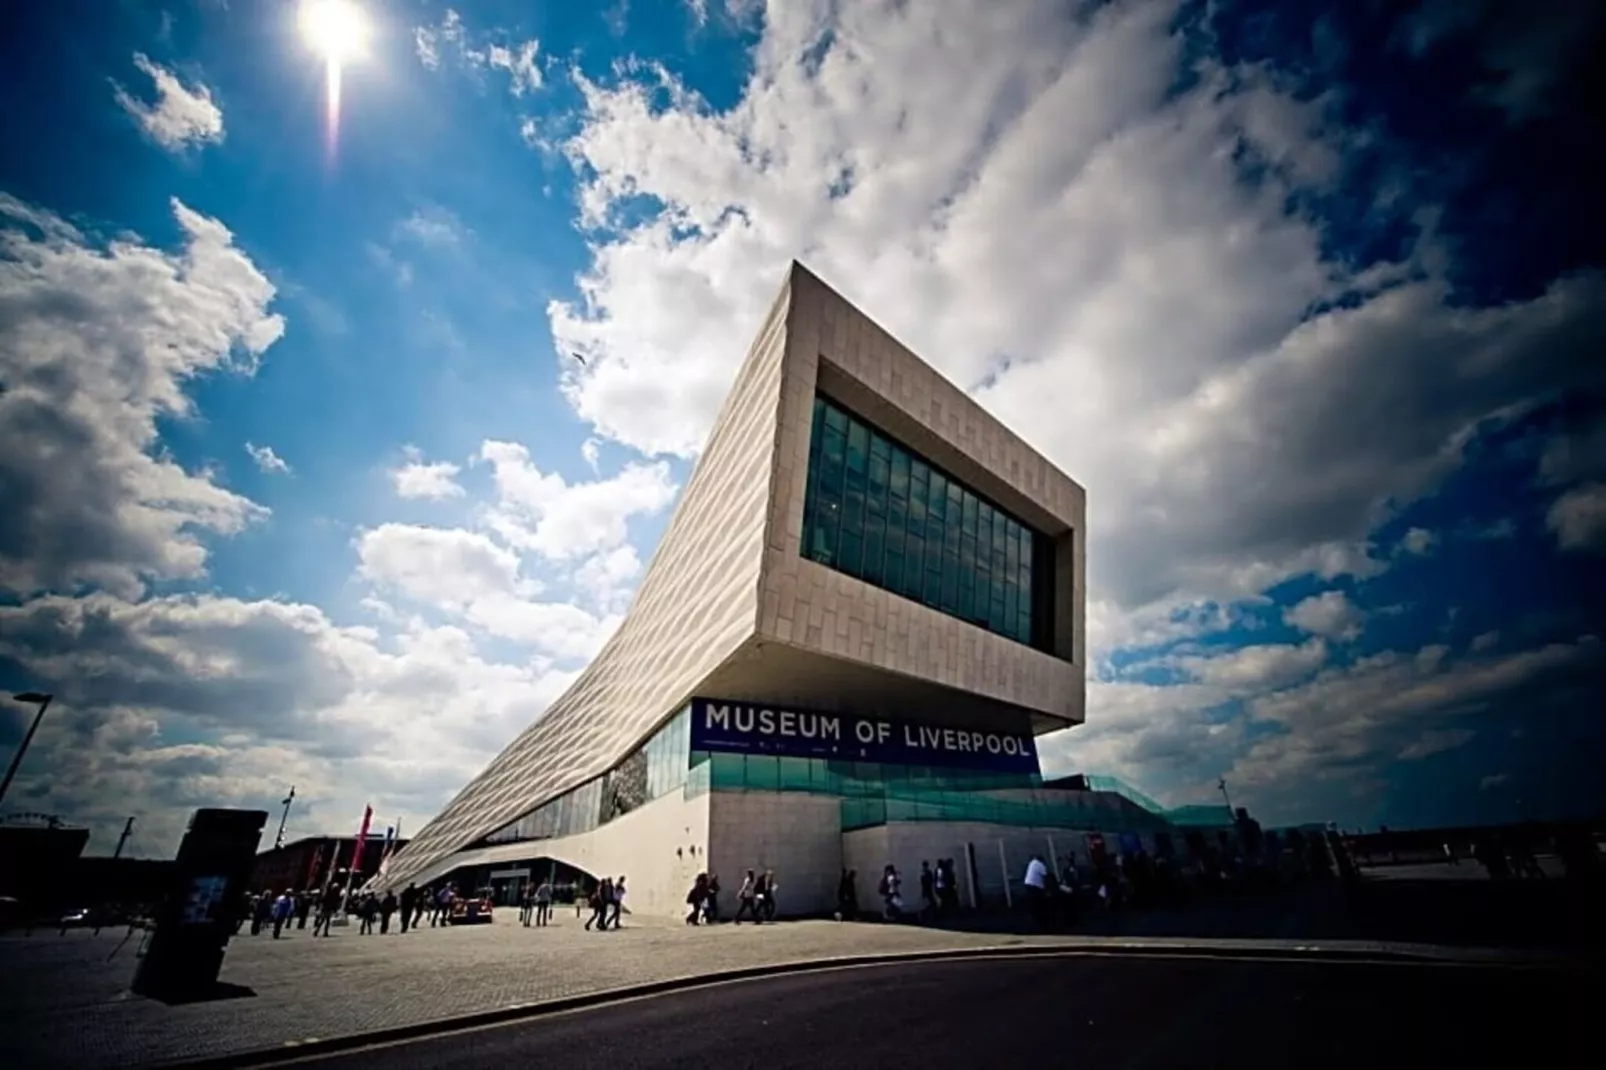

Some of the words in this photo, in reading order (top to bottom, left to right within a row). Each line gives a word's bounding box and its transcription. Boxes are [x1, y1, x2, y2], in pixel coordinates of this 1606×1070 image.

[705, 703, 841, 741] MUSEUM
[855, 720, 891, 744] OF
[904, 725, 1031, 757] LIVERPOOL
